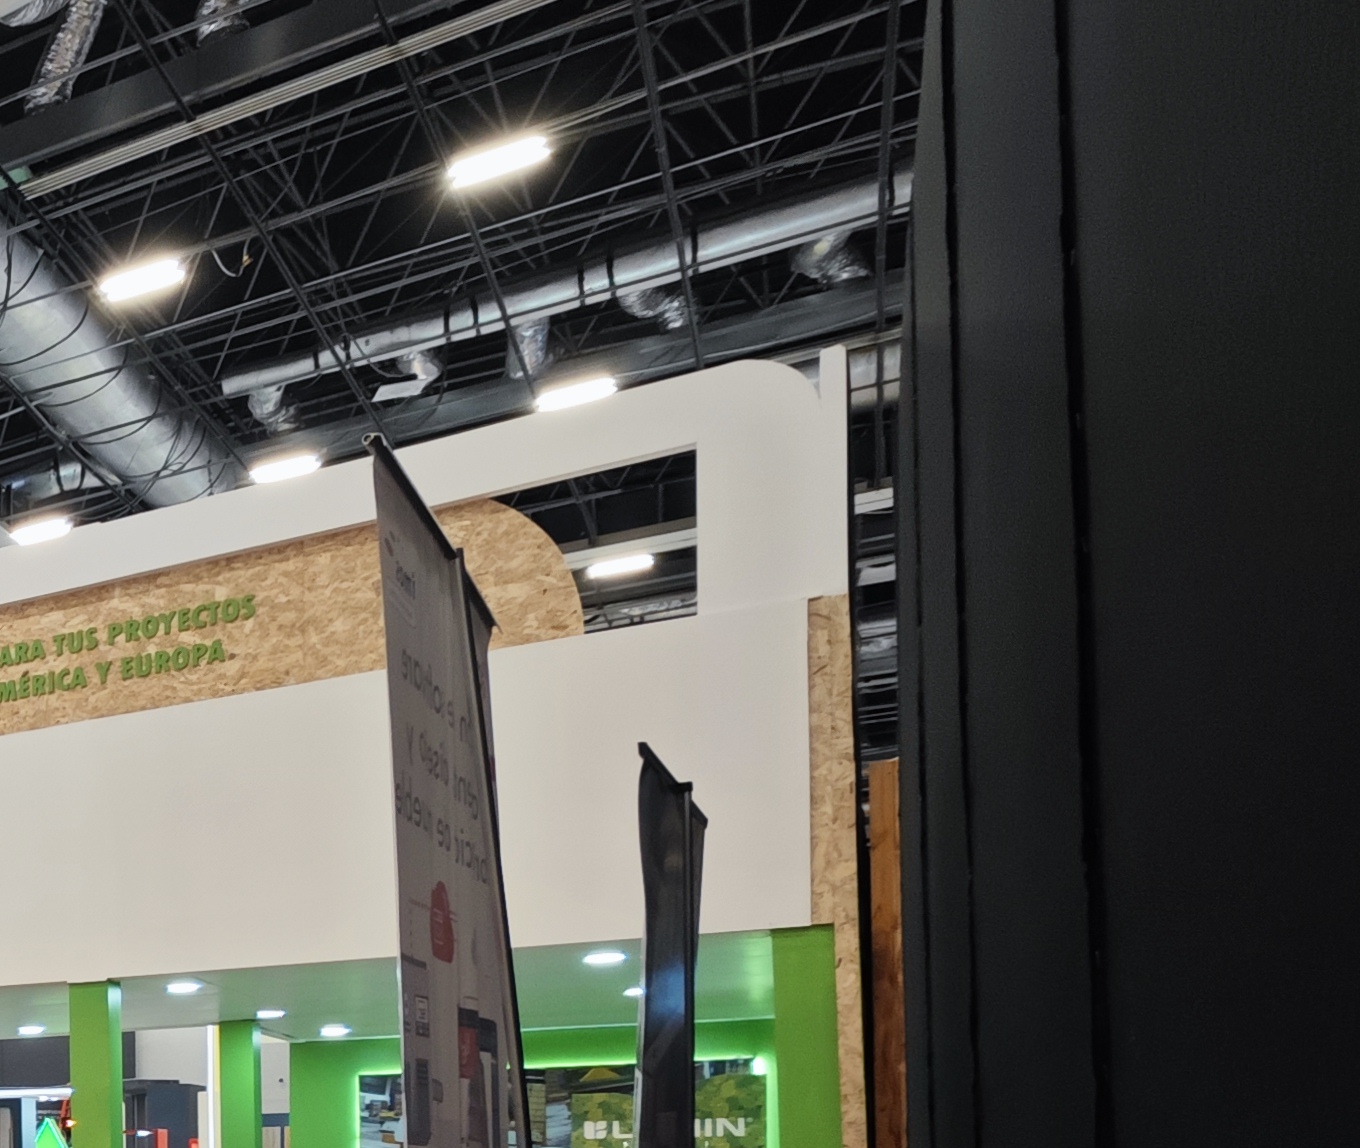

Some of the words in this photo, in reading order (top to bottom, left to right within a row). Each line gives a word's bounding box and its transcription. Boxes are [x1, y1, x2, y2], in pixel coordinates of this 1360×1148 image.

[53, 627, 99, 657] TUS
[107, 593, 256, 646] PROYECTOS
[95, 660, 113, 685] Y
